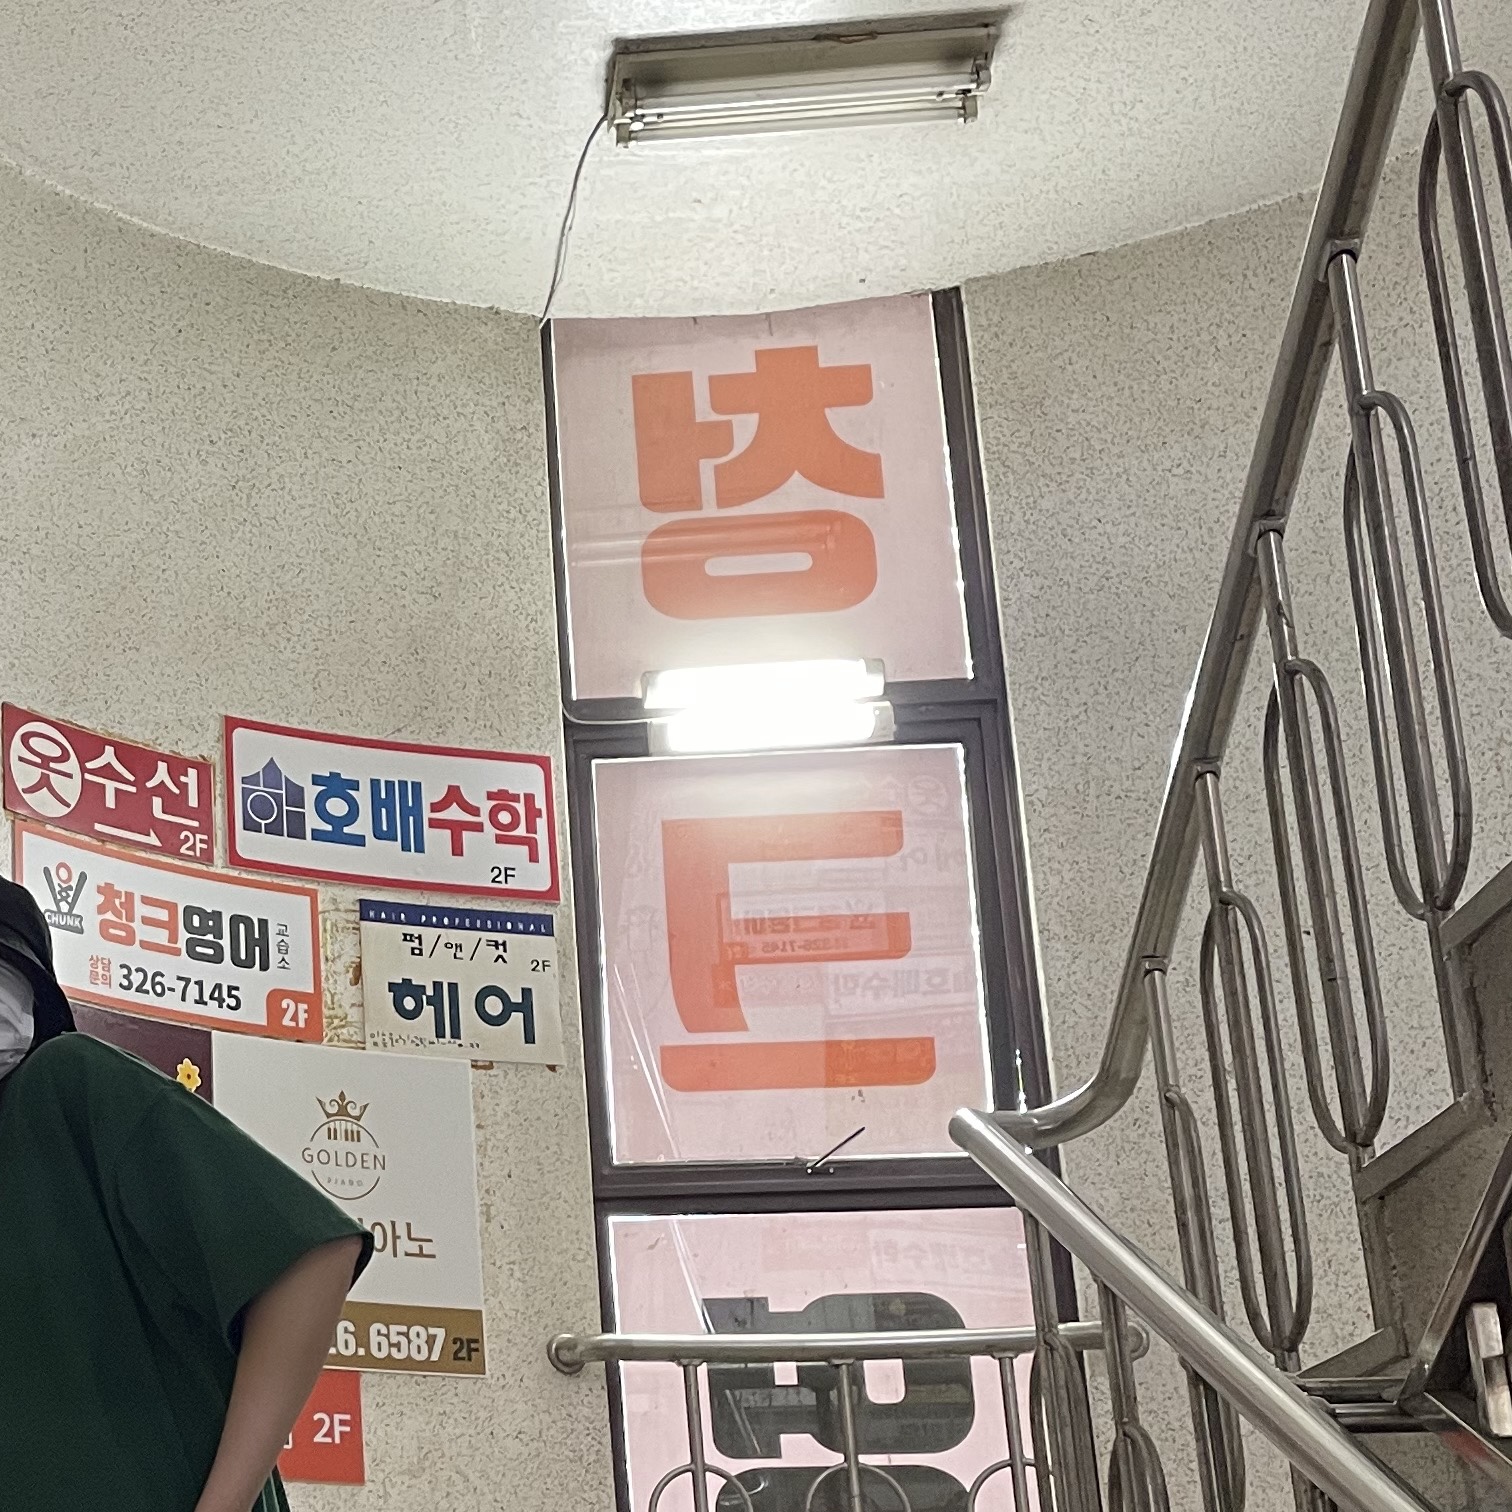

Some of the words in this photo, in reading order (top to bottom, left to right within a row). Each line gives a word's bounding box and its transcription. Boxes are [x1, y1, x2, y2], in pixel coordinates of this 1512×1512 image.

[311, 771, 543, 864] 호배수학
[179, 831, 209, 858] 2F
[490, 865, 516, 885] 2F
[46, 911, 82, 930] CHUNK
[96, 882, 271, 972] 청크영어
[368, 910, 406, 923] HAIR
[276, 922, 290, 971] 교습소
[530, 959, 551, 972] 2F
[118, 963, 243, 1013] 326-7145
[280, 998, 308, 1028] 2F
[301, 1146, 387, 1171] GOLDEN
[358, 1217, 437, 1260] 아노
[328, 1320, 445, 1361] 6.6587
[452, 1338, 479, 1361] 2F
[313, 1413, 351, 1443] 2F
